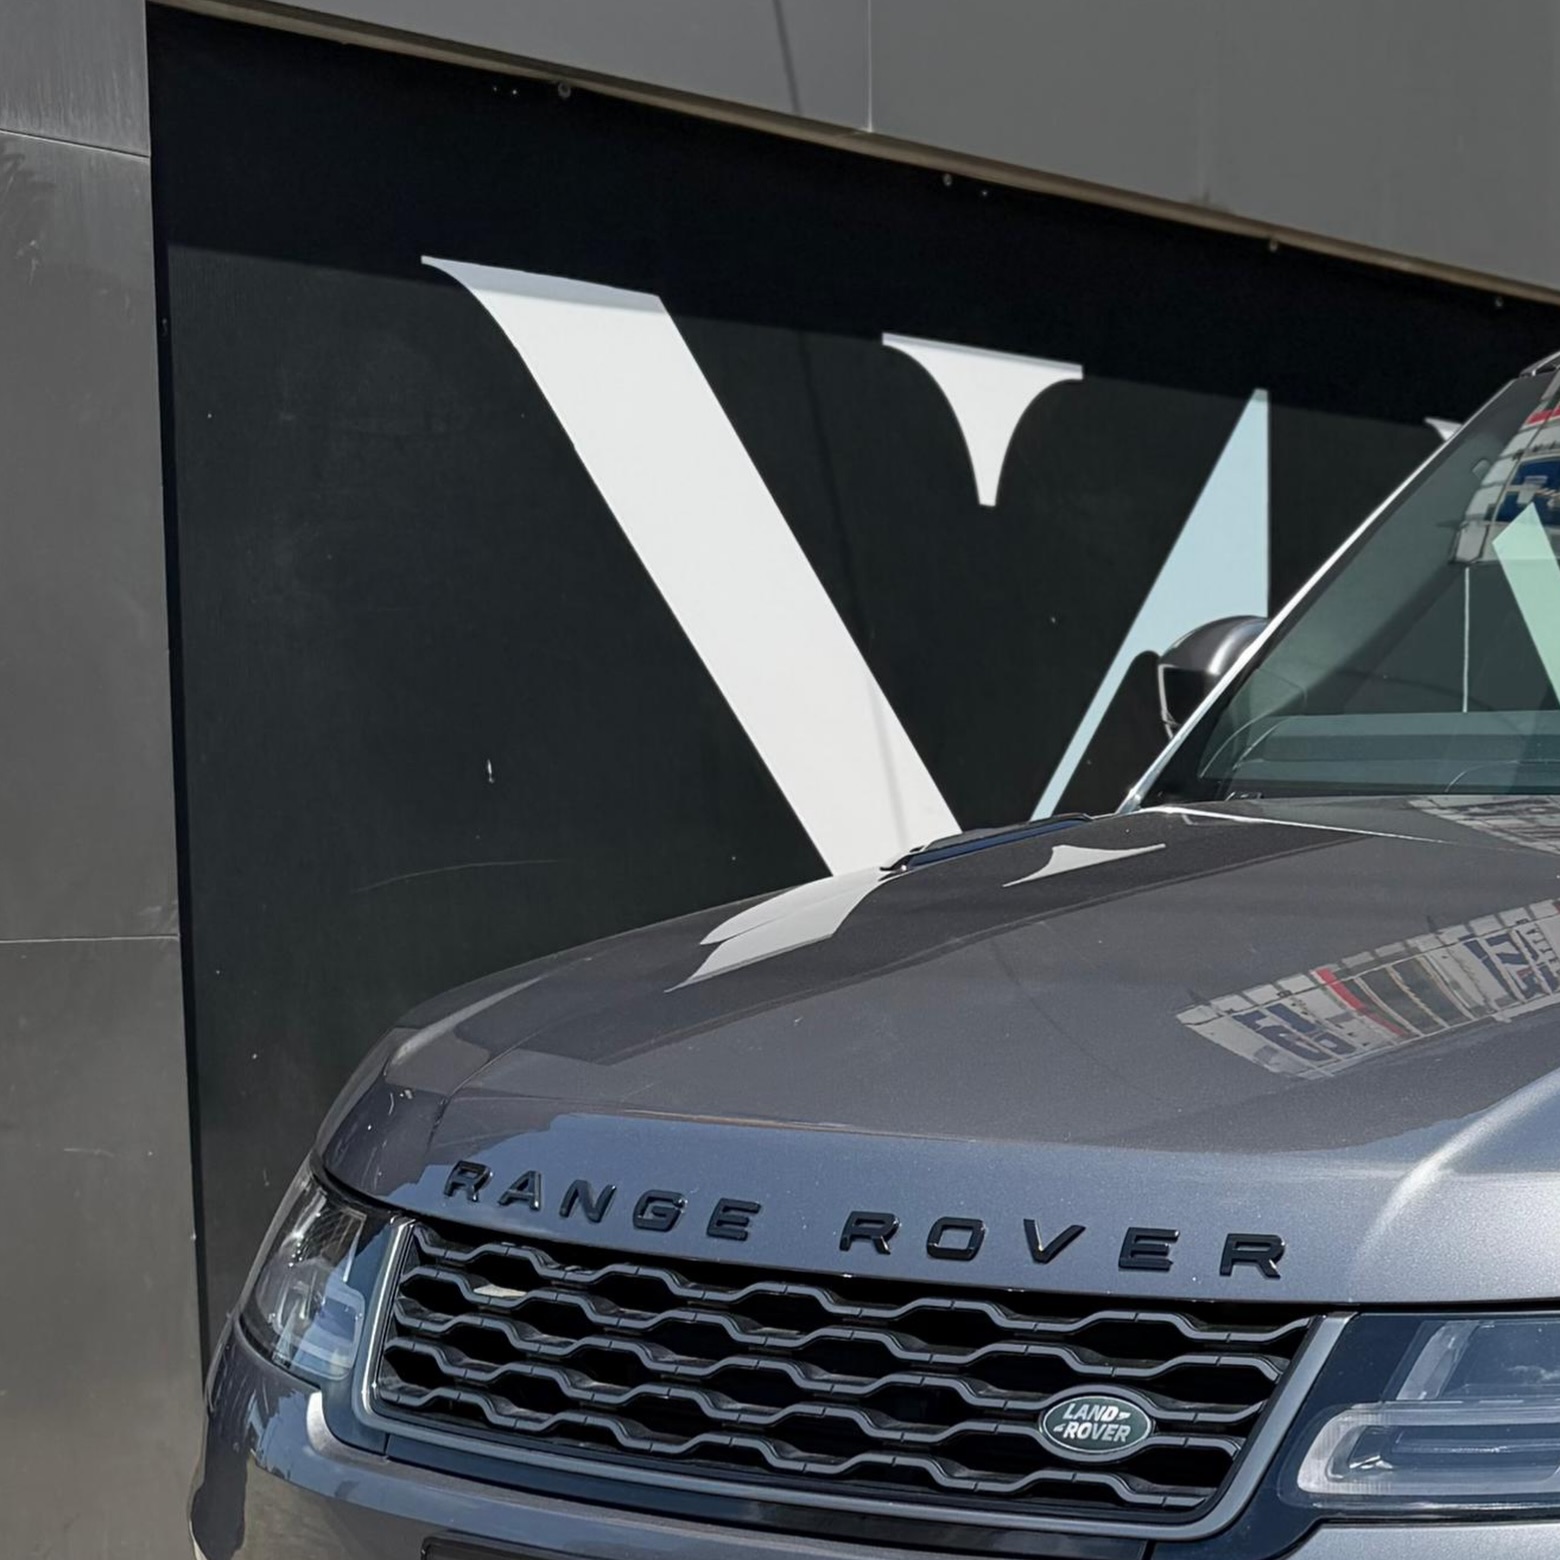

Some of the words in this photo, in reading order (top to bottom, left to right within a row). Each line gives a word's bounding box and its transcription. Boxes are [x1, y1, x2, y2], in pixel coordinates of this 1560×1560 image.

[444, 1159, 762, 1242] RANGE
[839, 1209, 1288, 1280] ROVER
[1063, 1403, 1119, 1421] LAND
[1063, 1421, 1131, 1442] ROVER
